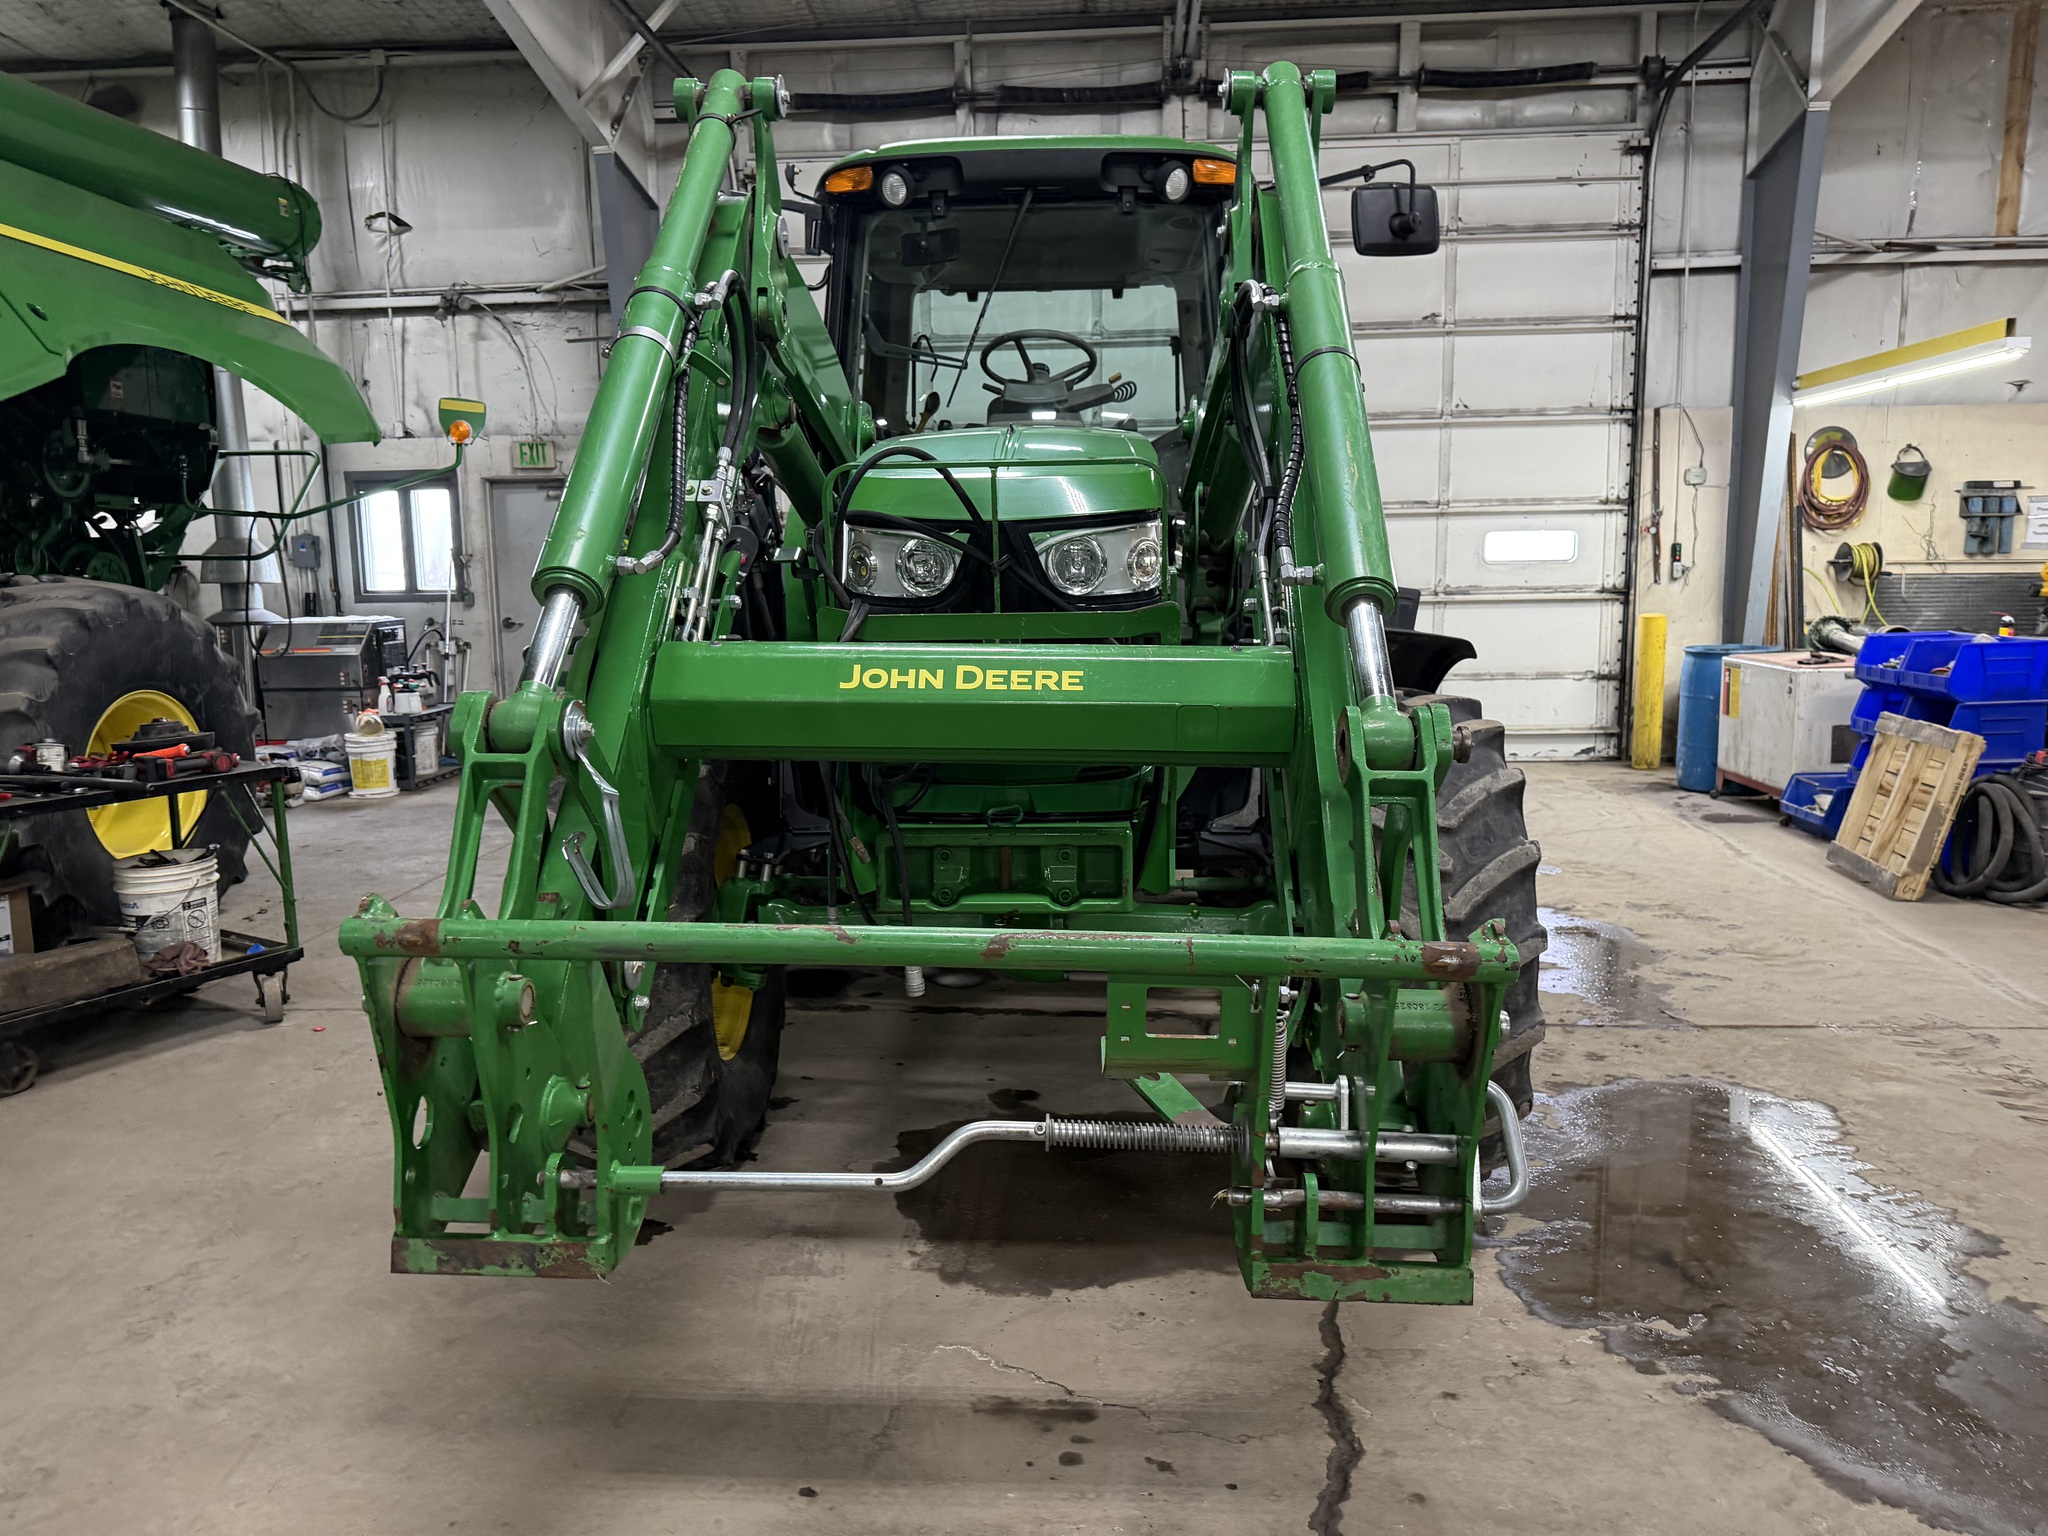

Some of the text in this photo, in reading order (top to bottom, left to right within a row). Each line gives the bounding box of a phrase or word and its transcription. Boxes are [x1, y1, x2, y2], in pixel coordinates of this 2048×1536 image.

[519, 442, 547, 466] EXIT
[839, 664, 1084, 692] JOHN DEERE
